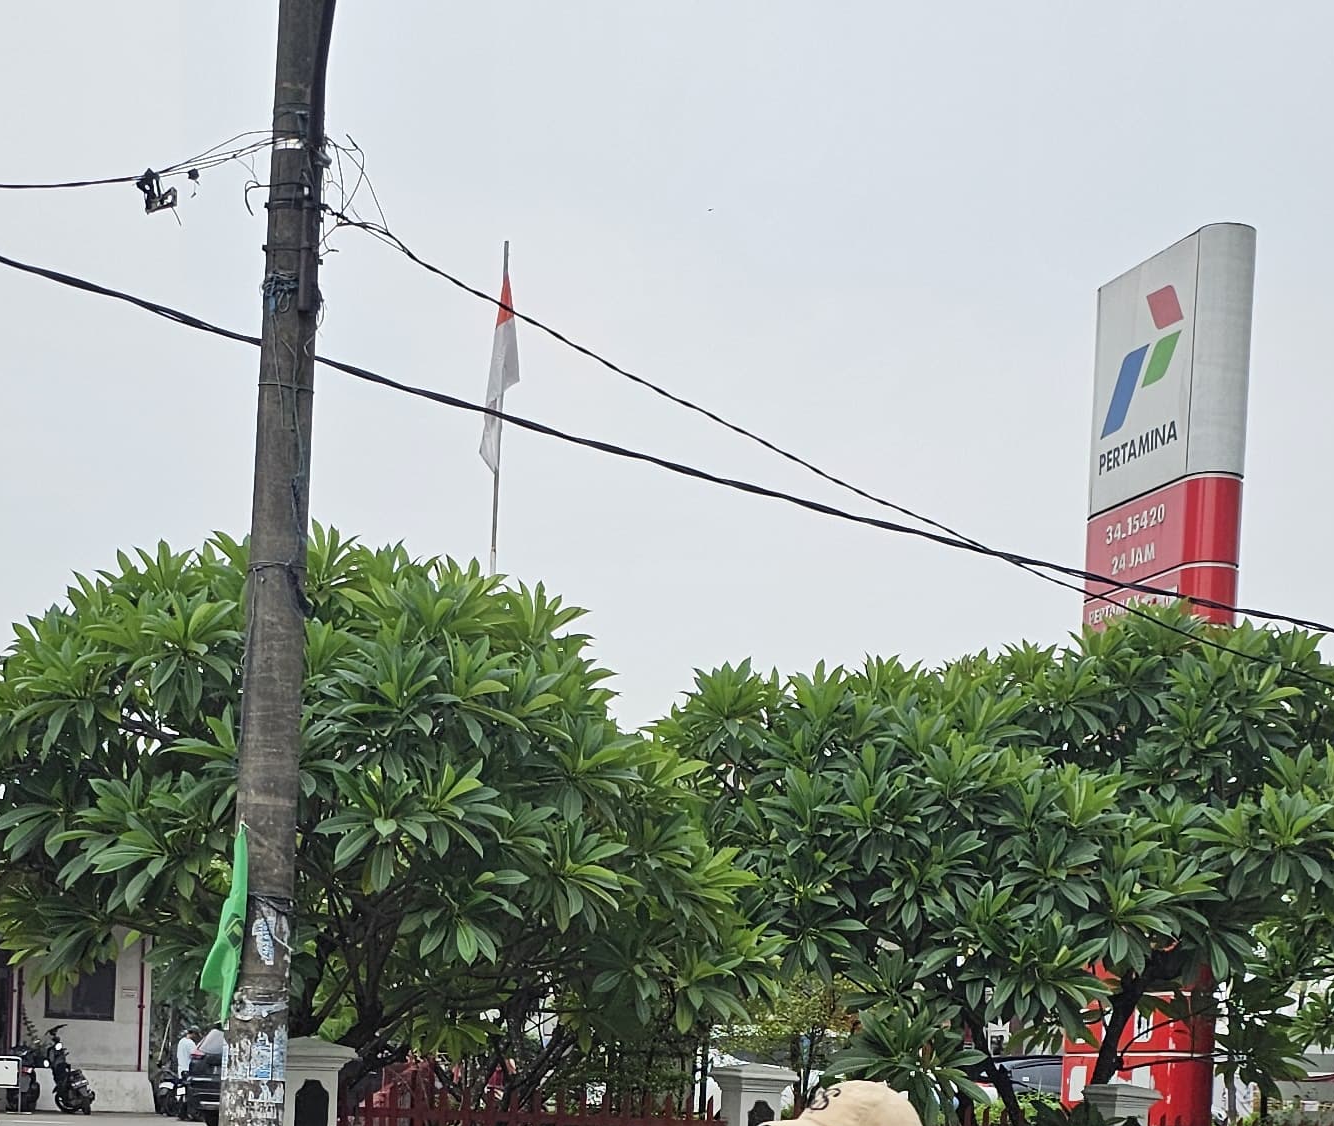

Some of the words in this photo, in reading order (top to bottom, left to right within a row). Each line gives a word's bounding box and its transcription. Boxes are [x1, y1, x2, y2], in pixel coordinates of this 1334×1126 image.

[1098, 420, 1178, 476] PERTAMINA
[1105, 503, 1166, 546] 34.15420
[1111, 553, 1127, 575] 24
[1128, 541, 1156, 568] JAM
